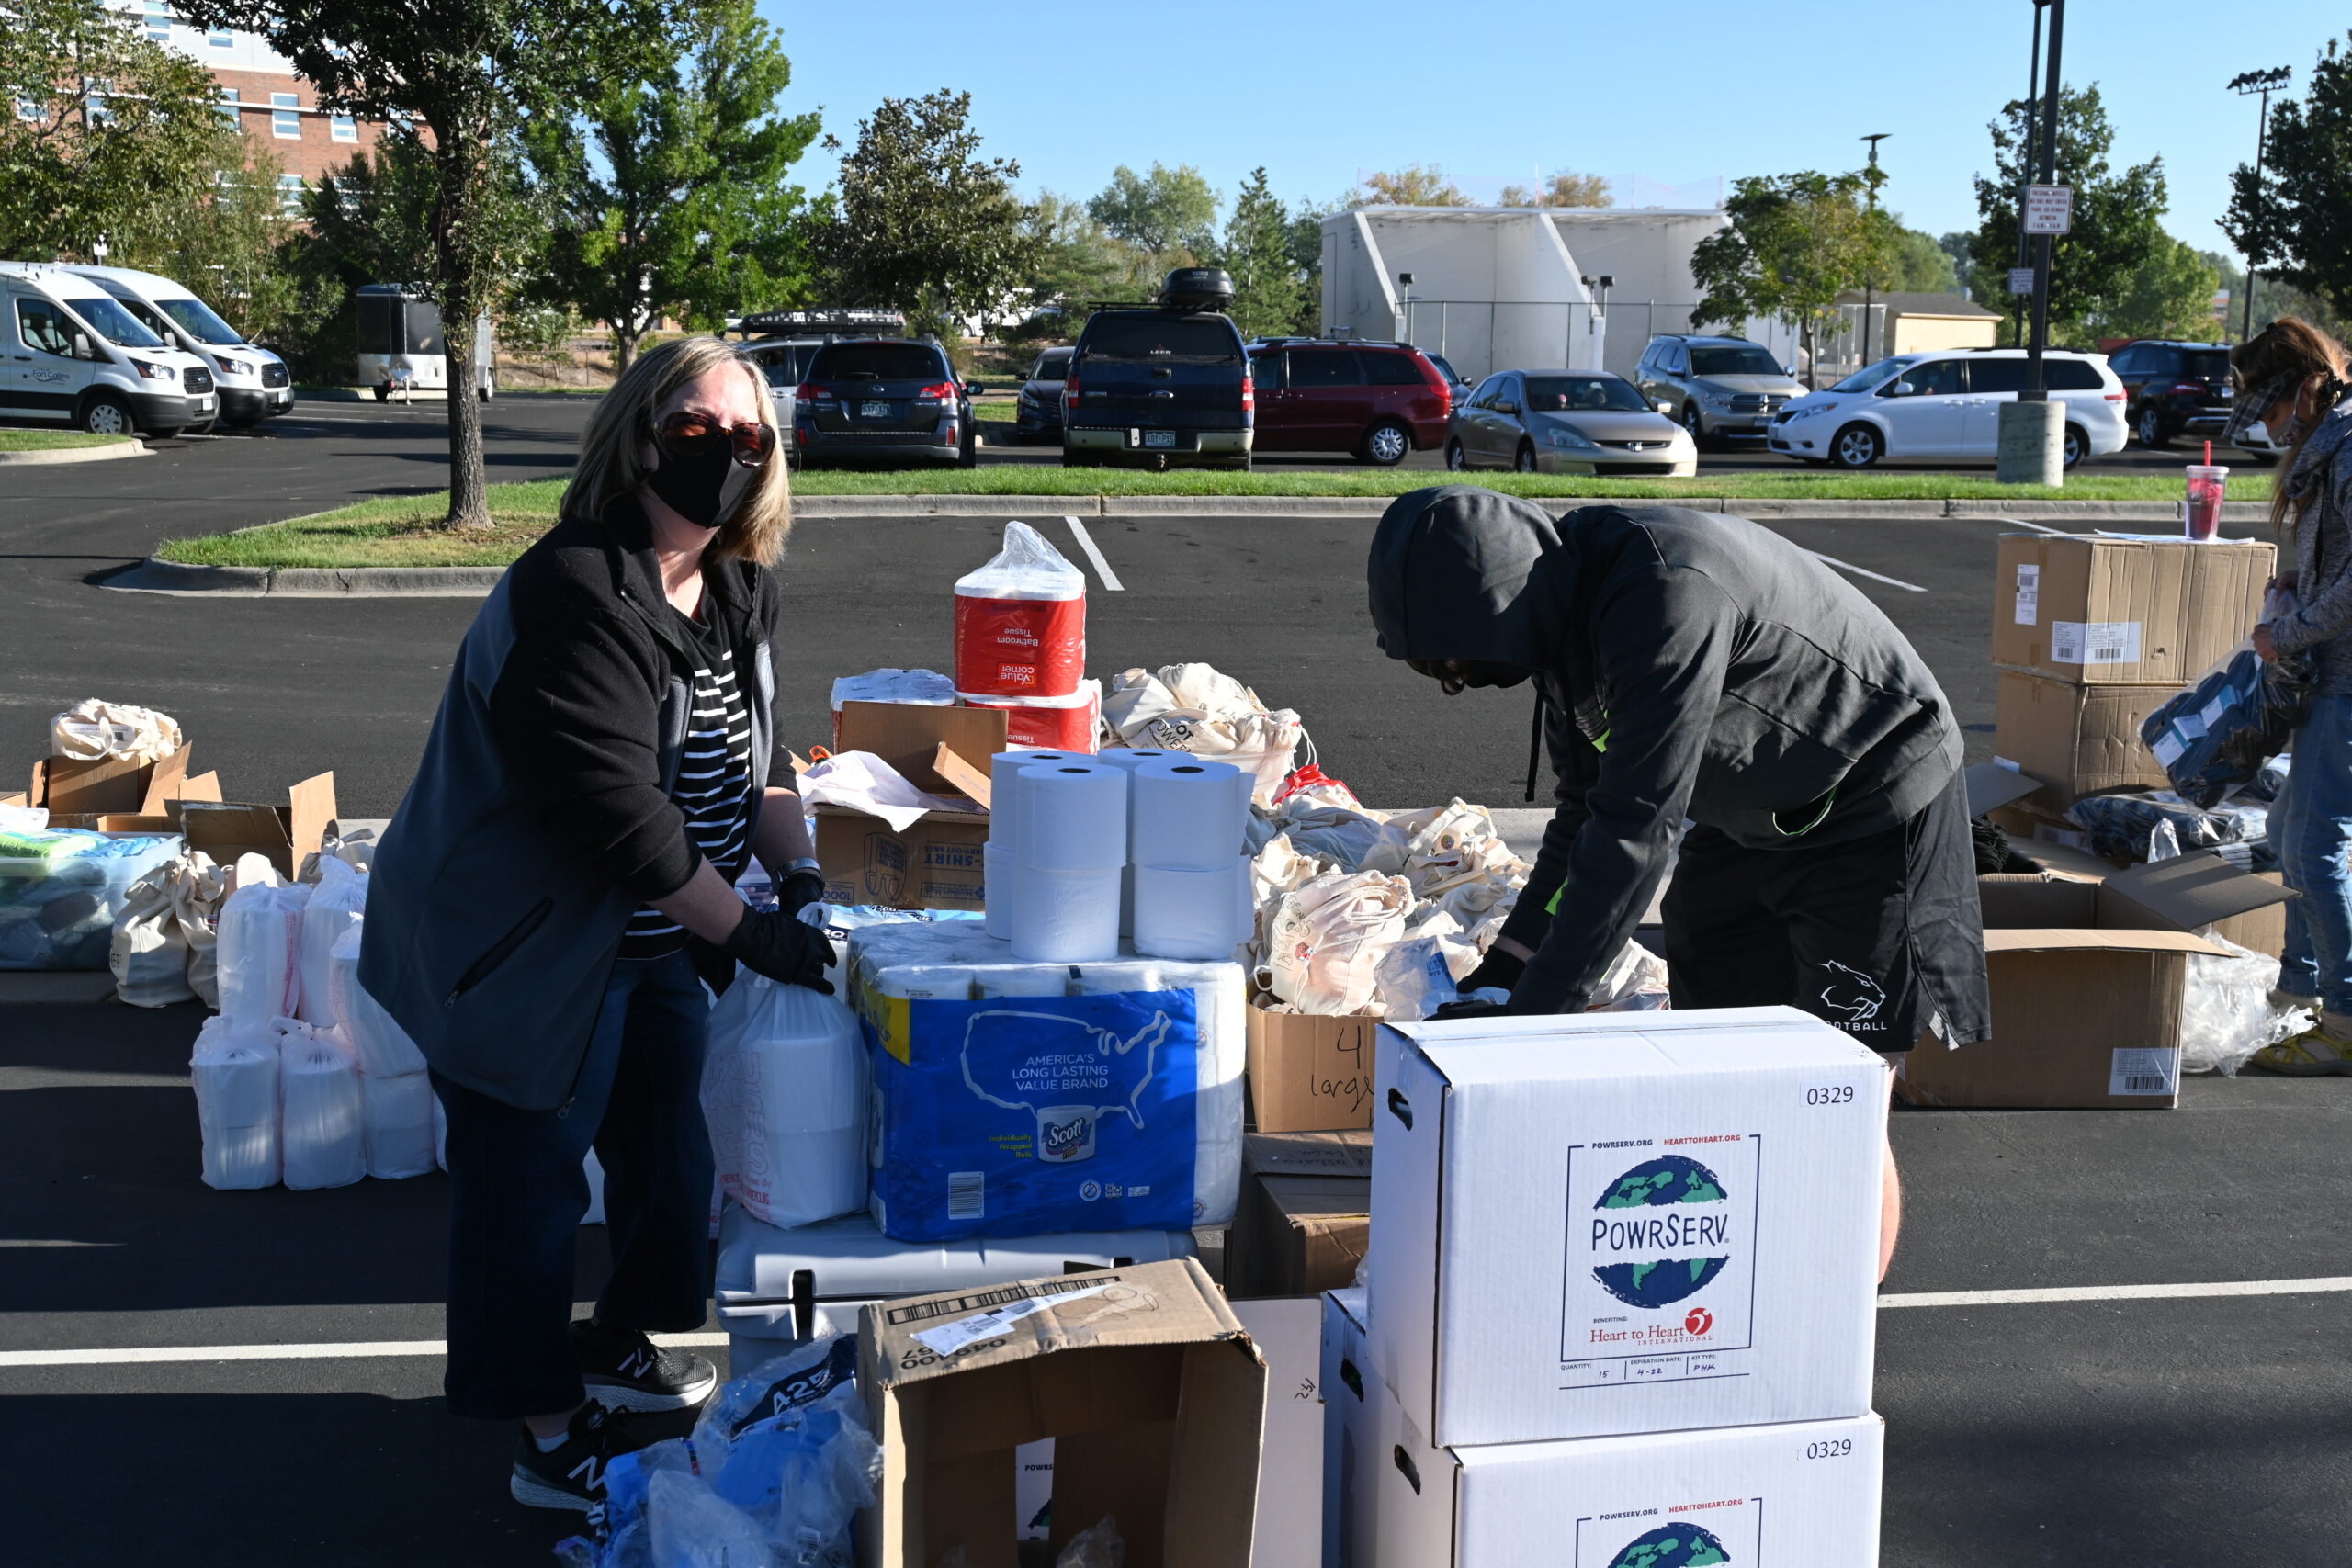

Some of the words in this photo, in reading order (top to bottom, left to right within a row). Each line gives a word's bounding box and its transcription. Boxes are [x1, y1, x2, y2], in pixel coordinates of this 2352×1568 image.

[33, 369, 46, 378] Fort
[1004, 628, 1032, 637] Tissue
[997, 637, 1038, 647] Bathroom
[1001, 665, 1035, 674] corner
[1000, 671, 1032, 685] Value
[1008, 734, 1035, 744] Tissue
[924, 853, 984, 867] -SHIRT
[1825, 1021, 1887, 1031] OTBALL
[1337, 1025, 1361, 1069] 4
[1025, 1054, 1095, 1066] AMERICA'S
[1012, 1067, 1049, 1079] LONG
[1053, 1066, 1109, 1077] LASTING
[1016, 1080, 1057, 1091] VALUE
[1062, 1078, 1109, 1090] BRAND
[1806, 1085, 1854, 1105] 0329
[989, 1134, 1032, 1143] Individually
[1048, 1118, 1084, 1147] Scott
[1592, 1139, 1653, 1149] POWRSERV.ORG
[1664, 1134, 1741, 1145] HEARTTOHEART.ORG
[1593, 1316, 1629, 1325] BENEFITING:
[1589, 1328, 1627, 1344] Heart
[1631, 1329, 1644, 1340] to
[1648, 1325, 1685, 1338] Heart
[1638, 1335, 1713, 1346] INTERNATIONAL
[1561, 1362, 1592, 1371] QUANTITY:
[1630, 1357, 1664, 1366] EXPIRATION
[1665, 1356, 1682, 1364] DATE:
[1806, 1438, 1852, 1460] 0329
[1600, 1507, 1659, 1521] POWRSERV.ORG
[1668, 1498, 1743, 1514] HEARTTOHEART.ORG
